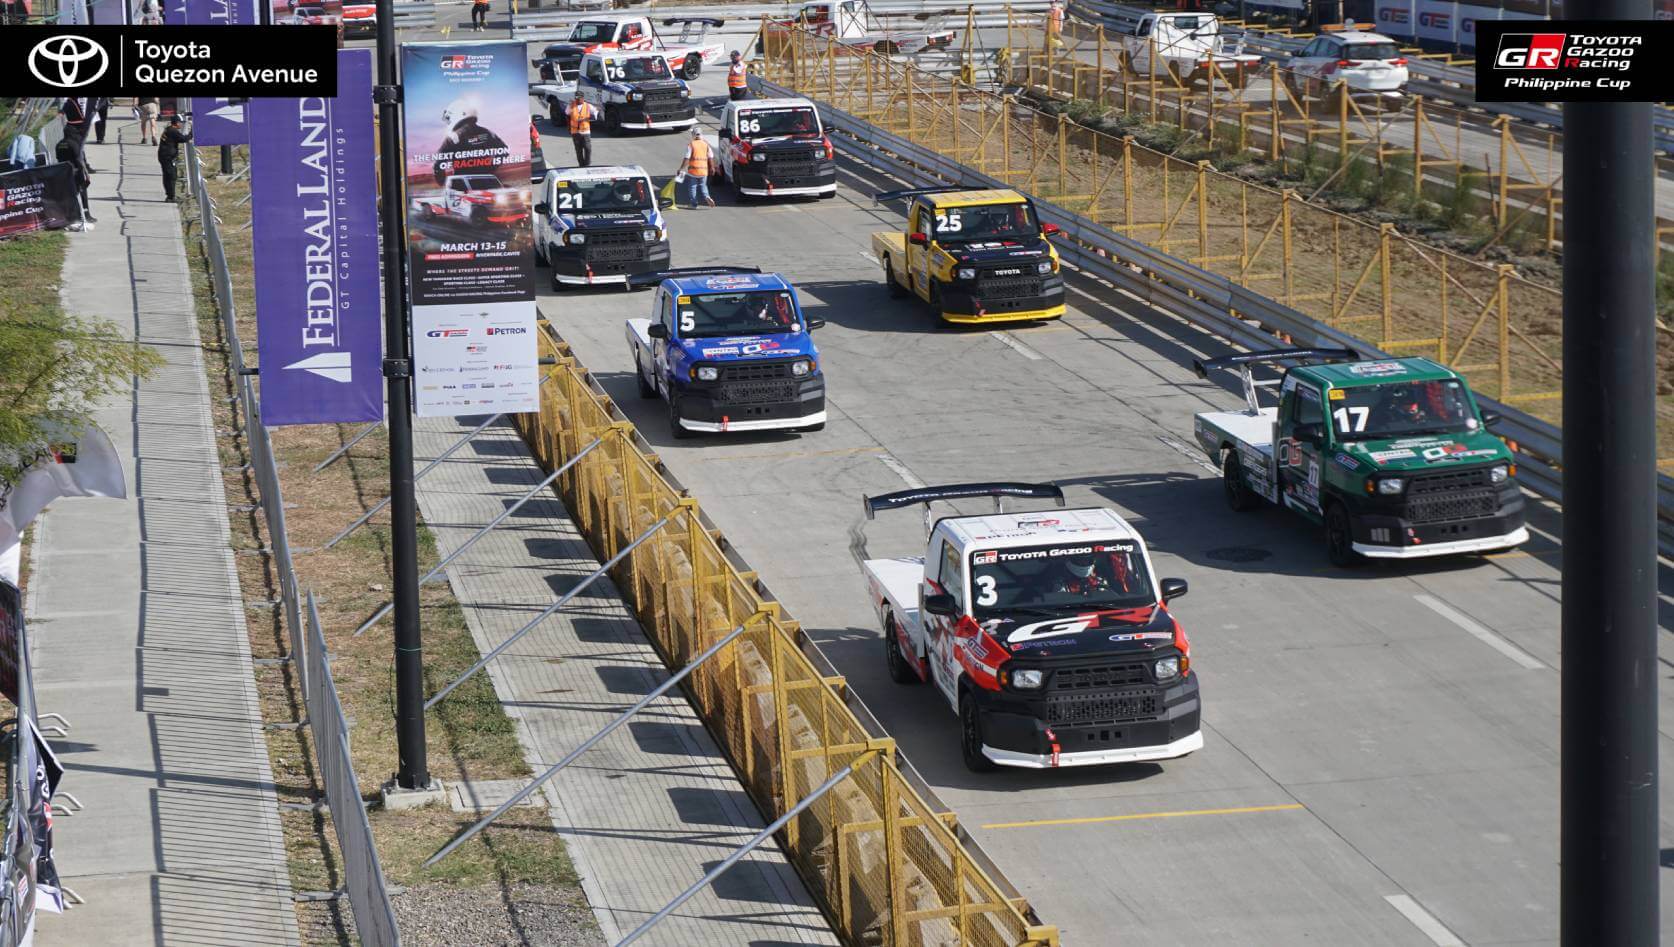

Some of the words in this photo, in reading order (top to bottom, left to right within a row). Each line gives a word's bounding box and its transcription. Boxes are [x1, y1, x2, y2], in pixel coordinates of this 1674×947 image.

[1462, 17, 1476, 32] G
[441, 60, 464, 69] GR
[607, 67, 626, 79] 76
[740, 119, 761, 133] 86
[297, 97, 331, 197] LAND
[413, 154, 431, 162] THE
[432, 152, 454, 160] NEXT
[454, 147, 510, 159] GENERATION
[335, 127, 347, 205] Holdings
[439, 161, 453, 170] OF
[453, 158, 493, 168] RACING
[492, 157, 501, 165] IS
[502, 155, 526, 164] HERE
[7, 183, 45, 194] TOYOTA
[7, 190, 42, 201] GAZOO
[7, 196, 42, 208] Racing
[559, 193, 583, 209] 21
[25, 206, 44, 214] Cup
[936, 214, 962, 231] 25
[339, 216, 350, 280] Capital
[440, 242, 479, 252] MARCH
[302, 198, 336, 348] FEDERAL
[994, 268, 1021, 276] TOYOTA
[341, 291, 350, 310] GT
[680, 311, 695, 332] 5
[494, 327, 527, 336] PETRON
[1333, 406, 1370, 433] 17
[975, 555, 998, 565] GR
[1000, 550, 1047, 561] TOYOTA
[1050, 547, 1092, 557] GAZOO
[1094, 544, 1134, 553] Racing
[976, 575, 999, 607] 3
